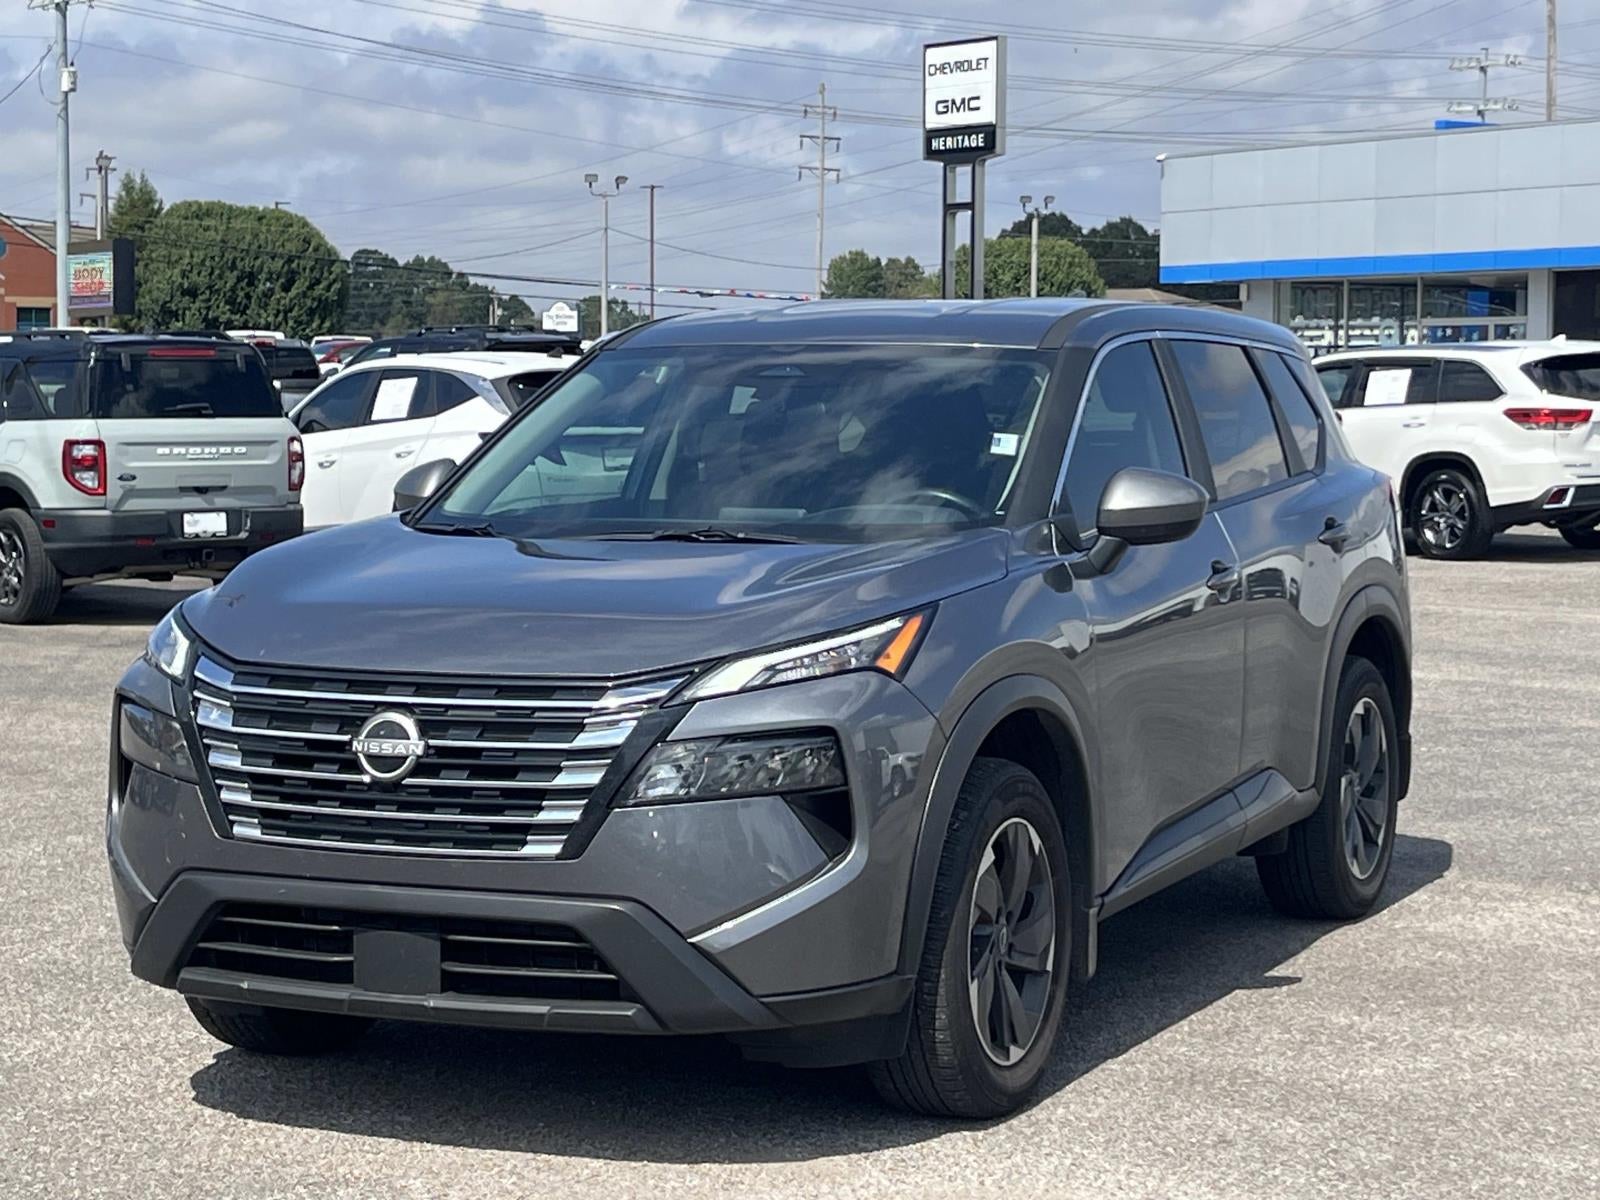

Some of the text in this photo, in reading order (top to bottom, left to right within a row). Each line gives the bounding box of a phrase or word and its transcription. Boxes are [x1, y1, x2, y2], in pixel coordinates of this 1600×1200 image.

[928, 57, 989, 77] CHEVROLET
[935, 95, 981, 115] GMC
[931, 133, 985, 151] HERITAGE
[156, 446, 247, 456] BRONCO
[352, 740, 425, 756] NISSAN
